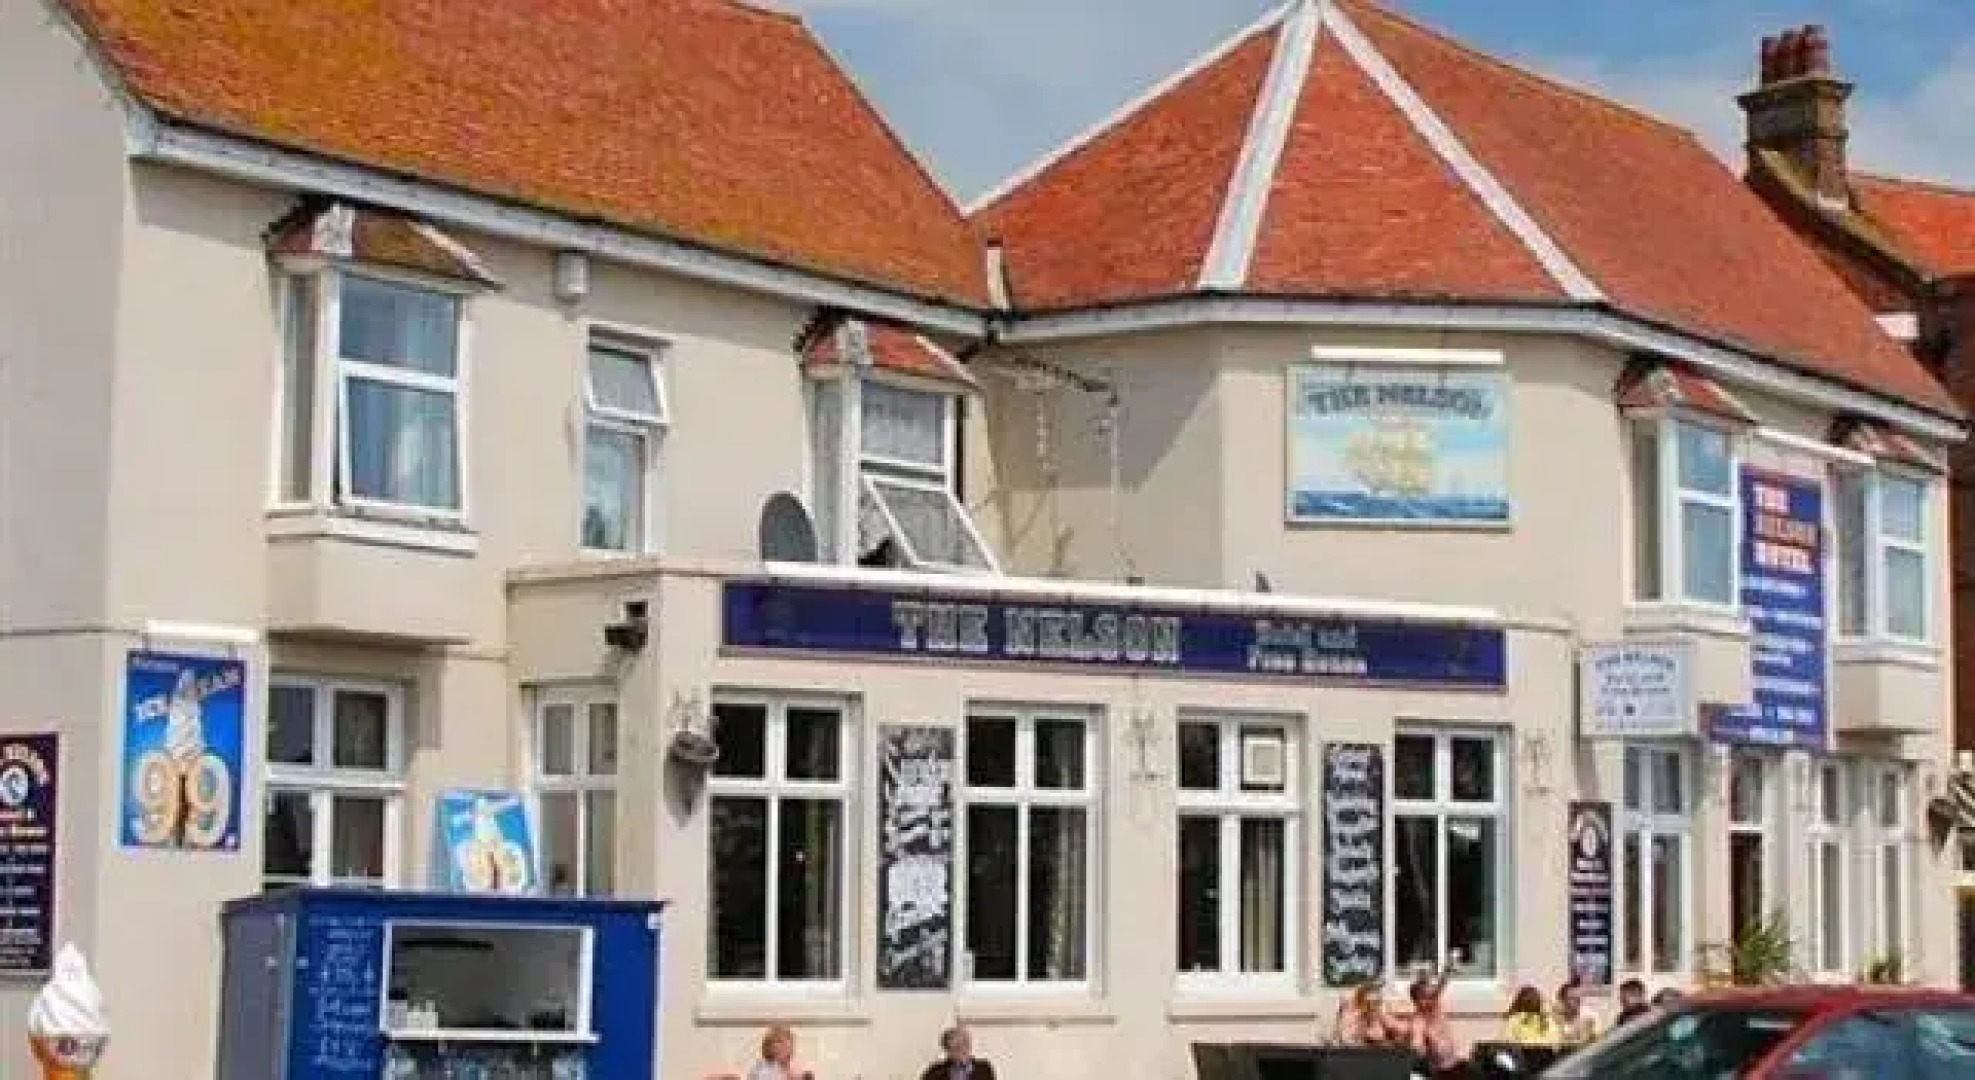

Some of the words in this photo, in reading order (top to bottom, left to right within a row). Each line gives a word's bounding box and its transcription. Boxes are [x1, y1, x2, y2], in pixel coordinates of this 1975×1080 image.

[1306, 382, 1371, 416] THE
[892, 601, 989, 652] THE
[1003, 607, 1180, 663] NELSON
[134, 752, 232, 848] 99
